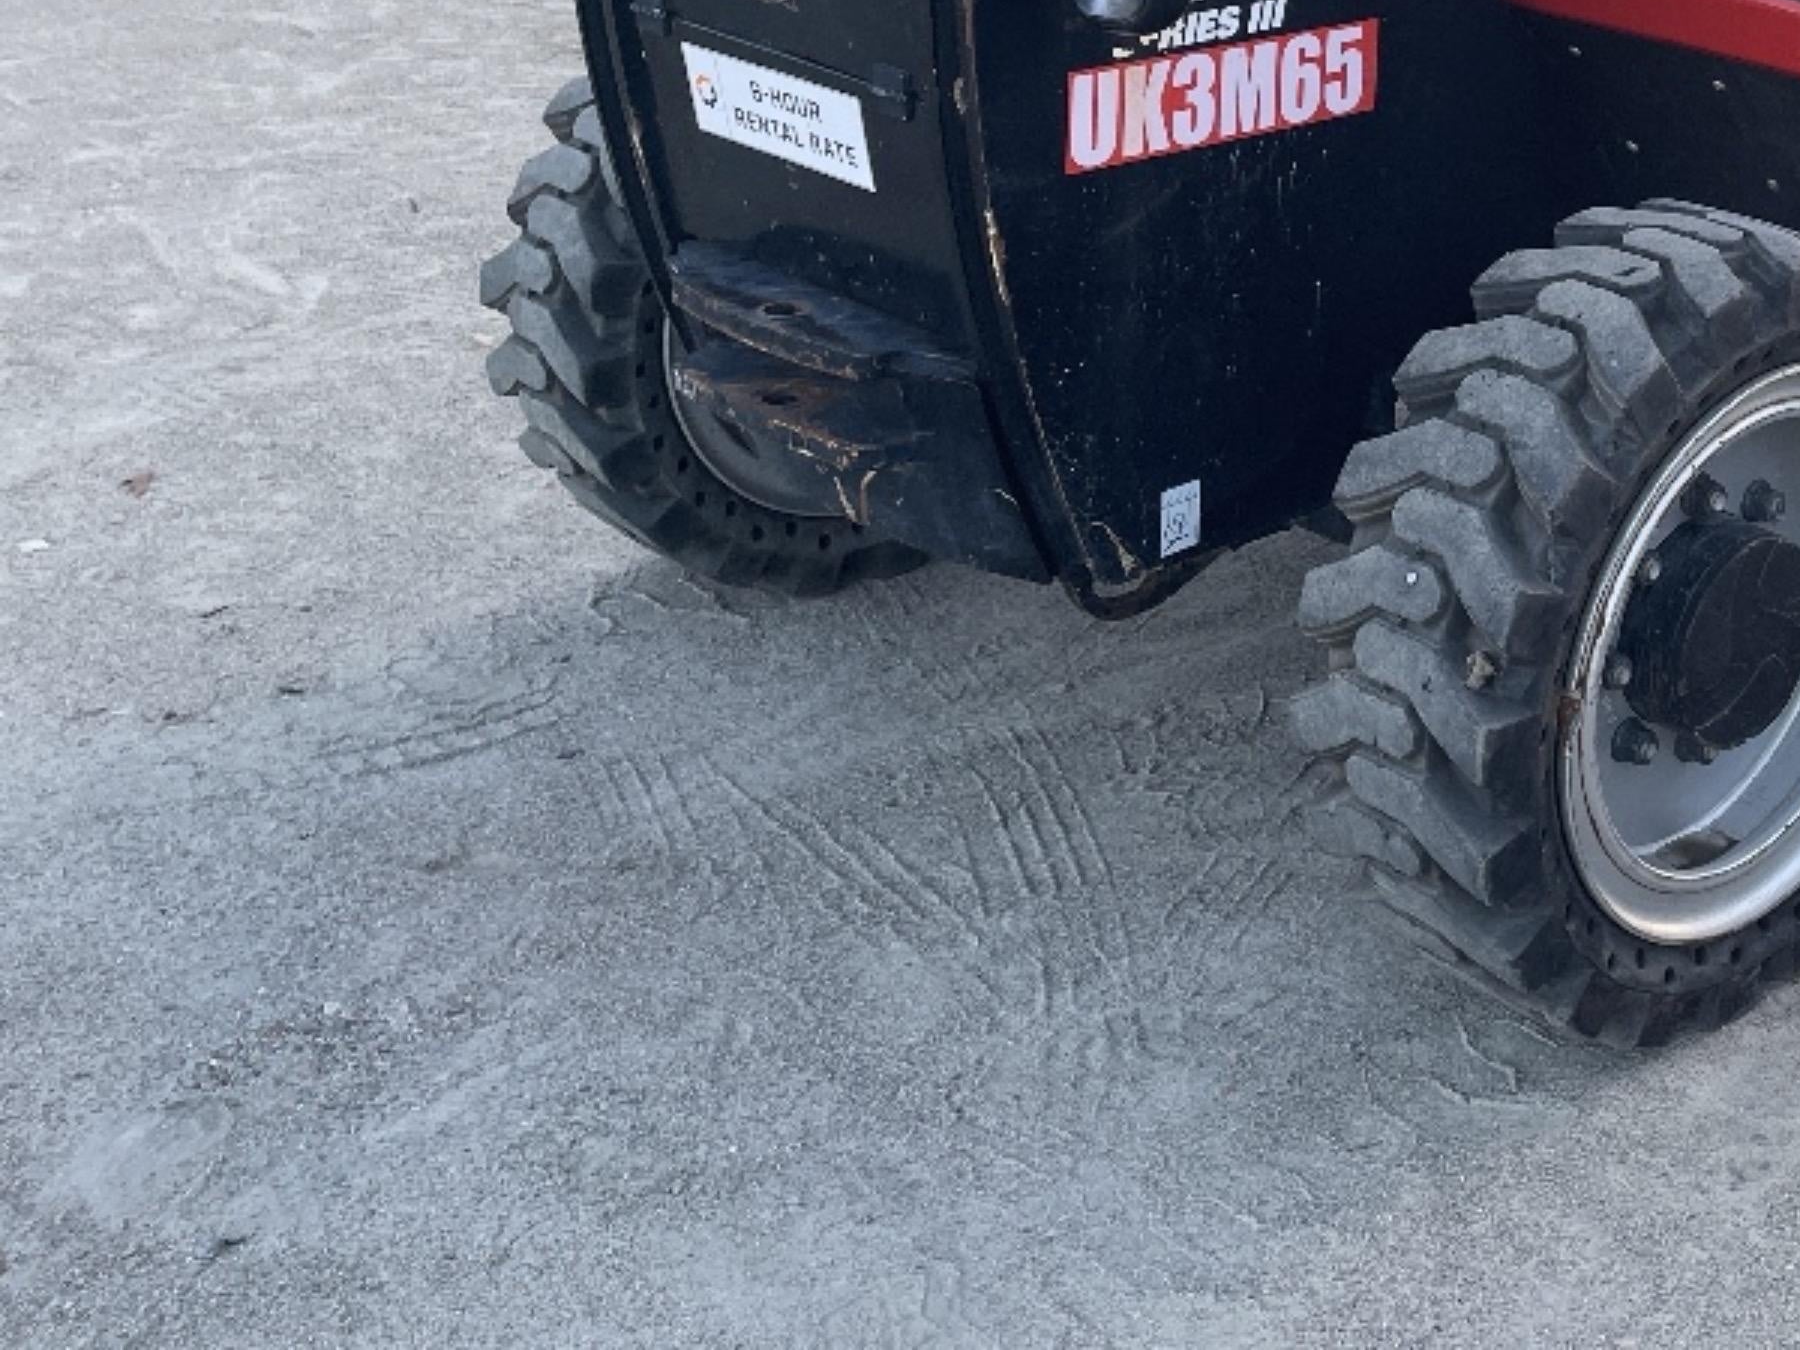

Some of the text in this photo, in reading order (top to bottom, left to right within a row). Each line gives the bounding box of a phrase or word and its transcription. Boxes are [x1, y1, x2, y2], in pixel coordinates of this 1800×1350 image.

[734, 106, 859, 168] RENTAL RATE
[1069, 25, 1363, 170] UK3M65
